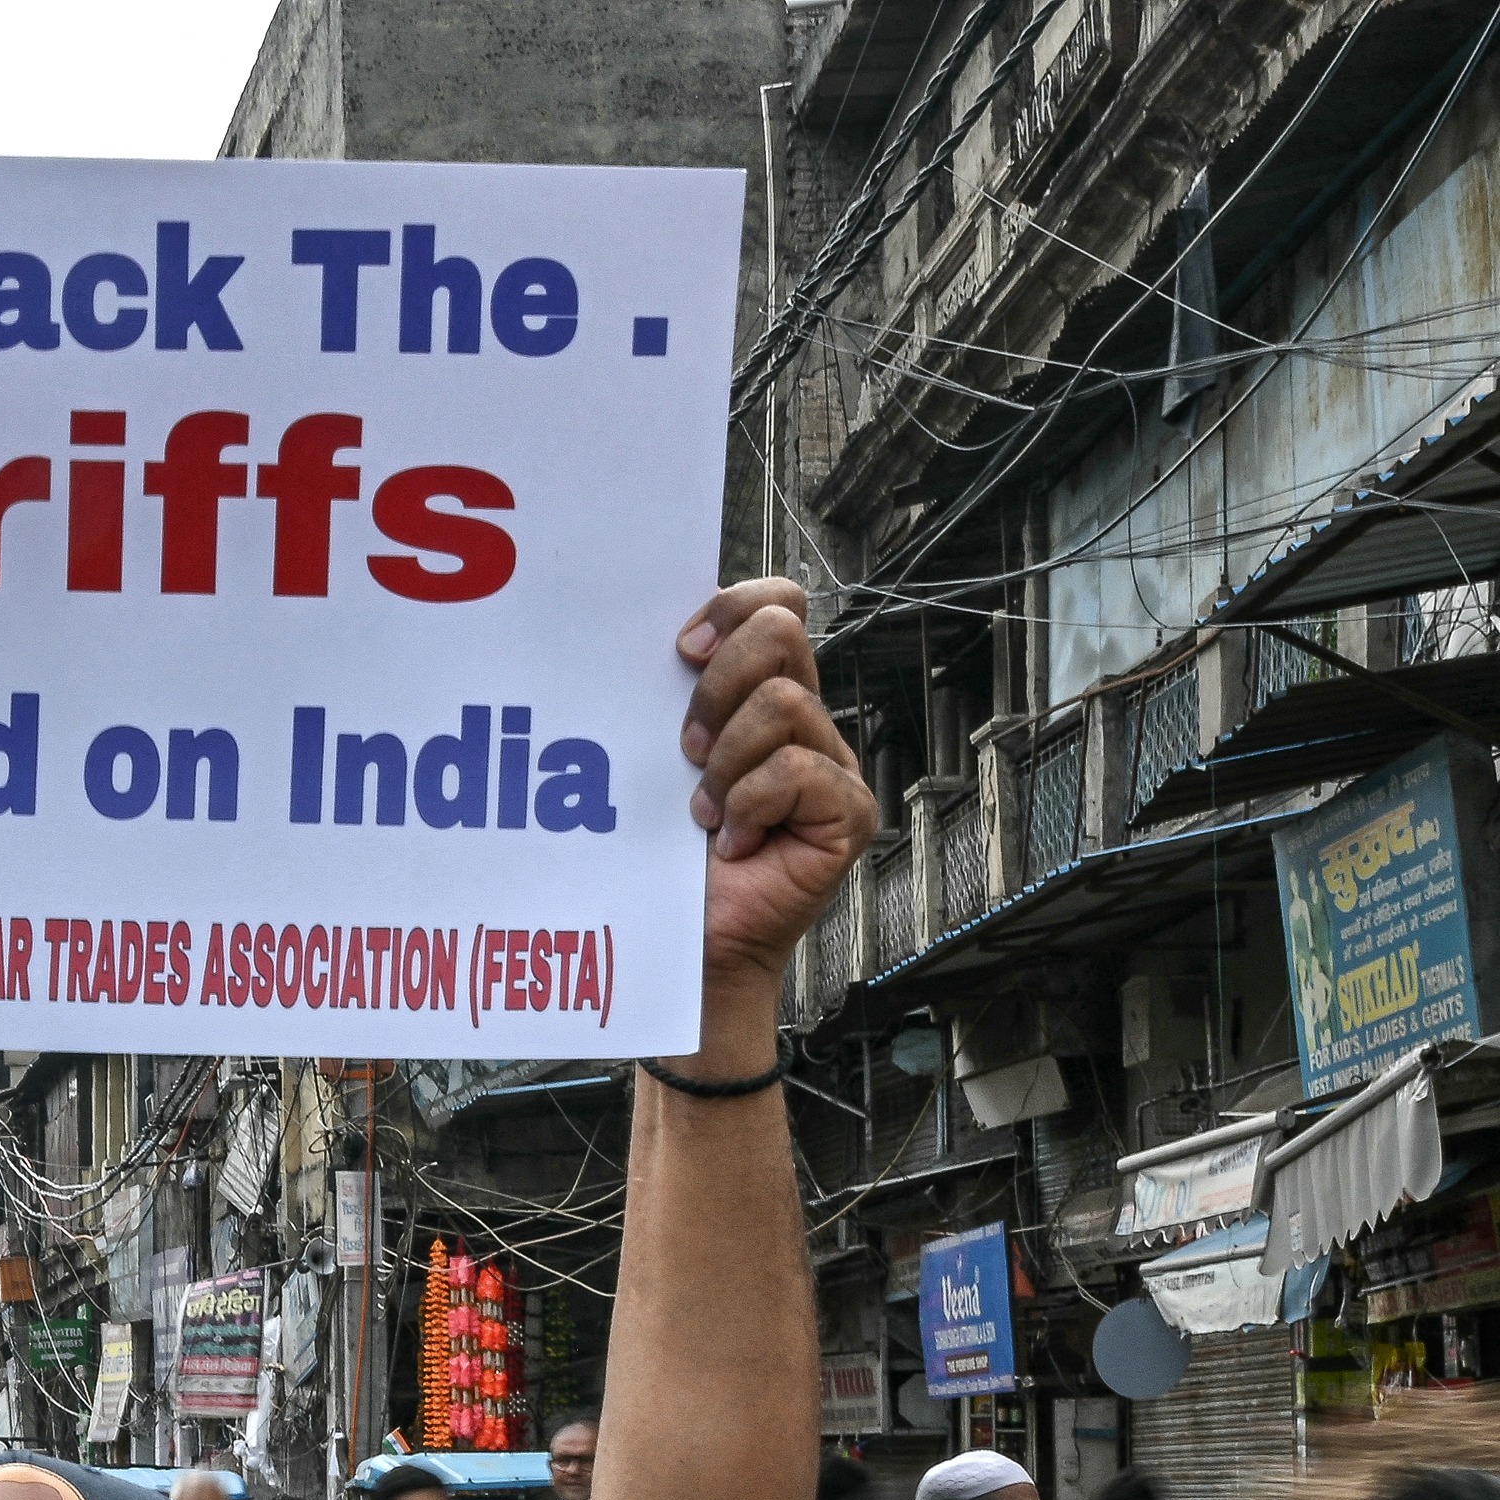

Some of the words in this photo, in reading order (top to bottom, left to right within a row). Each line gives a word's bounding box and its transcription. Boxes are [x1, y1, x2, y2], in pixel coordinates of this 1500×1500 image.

[291, 224, 579, 357] The
[83, 725, 240, 822] on
[289, 704, 617, 833] India
[1318, 800, 1416, 912] सुखद
[45, 919, 191, 1005] TRADES
[201, 924, 458, 1009] ASSOCIATION
[470, 928, 613, 1023] (FESTA)
[1337, 945, 1419, 1033] SUKHAD
[1309, 1046, 1331, 1073] FOR
[1365, 1016, 1408, 1050] LADIES
[1409, 1011, 1421, 1033] &
[1421, 993, 1465, 1029] GENTS
[941, 1273, 982, 1322] Veena
